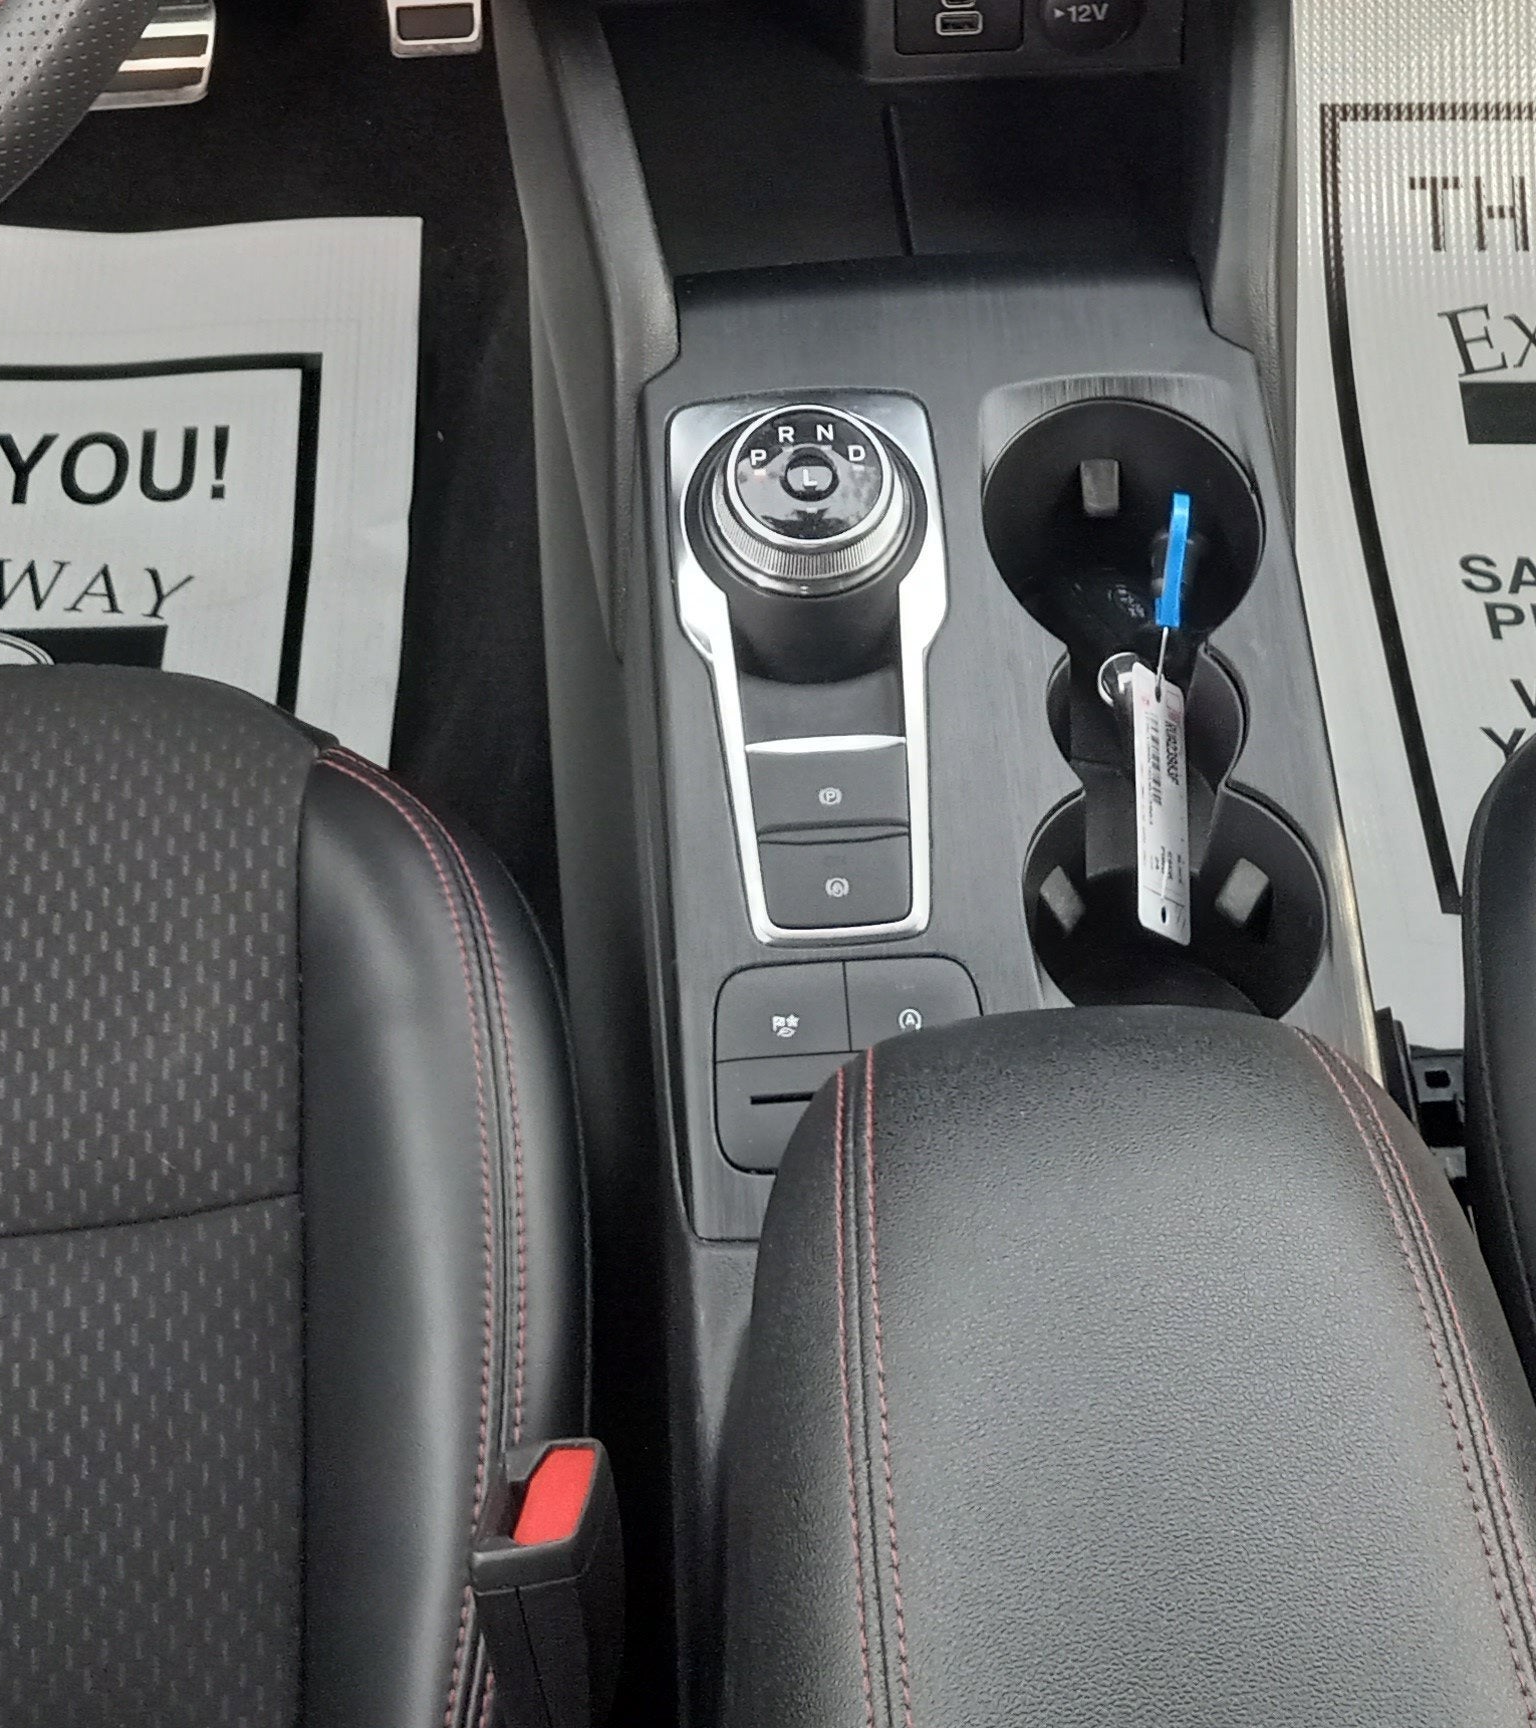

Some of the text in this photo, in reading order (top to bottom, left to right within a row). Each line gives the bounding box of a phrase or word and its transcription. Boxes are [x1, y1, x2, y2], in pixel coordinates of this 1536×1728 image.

[777, 426, 795, 443] R
[816, 423, 834, 441] N
[750, 449, 767, 466] P
[847, 444, 866, 462] D
[802, 468, 818, 486] L
